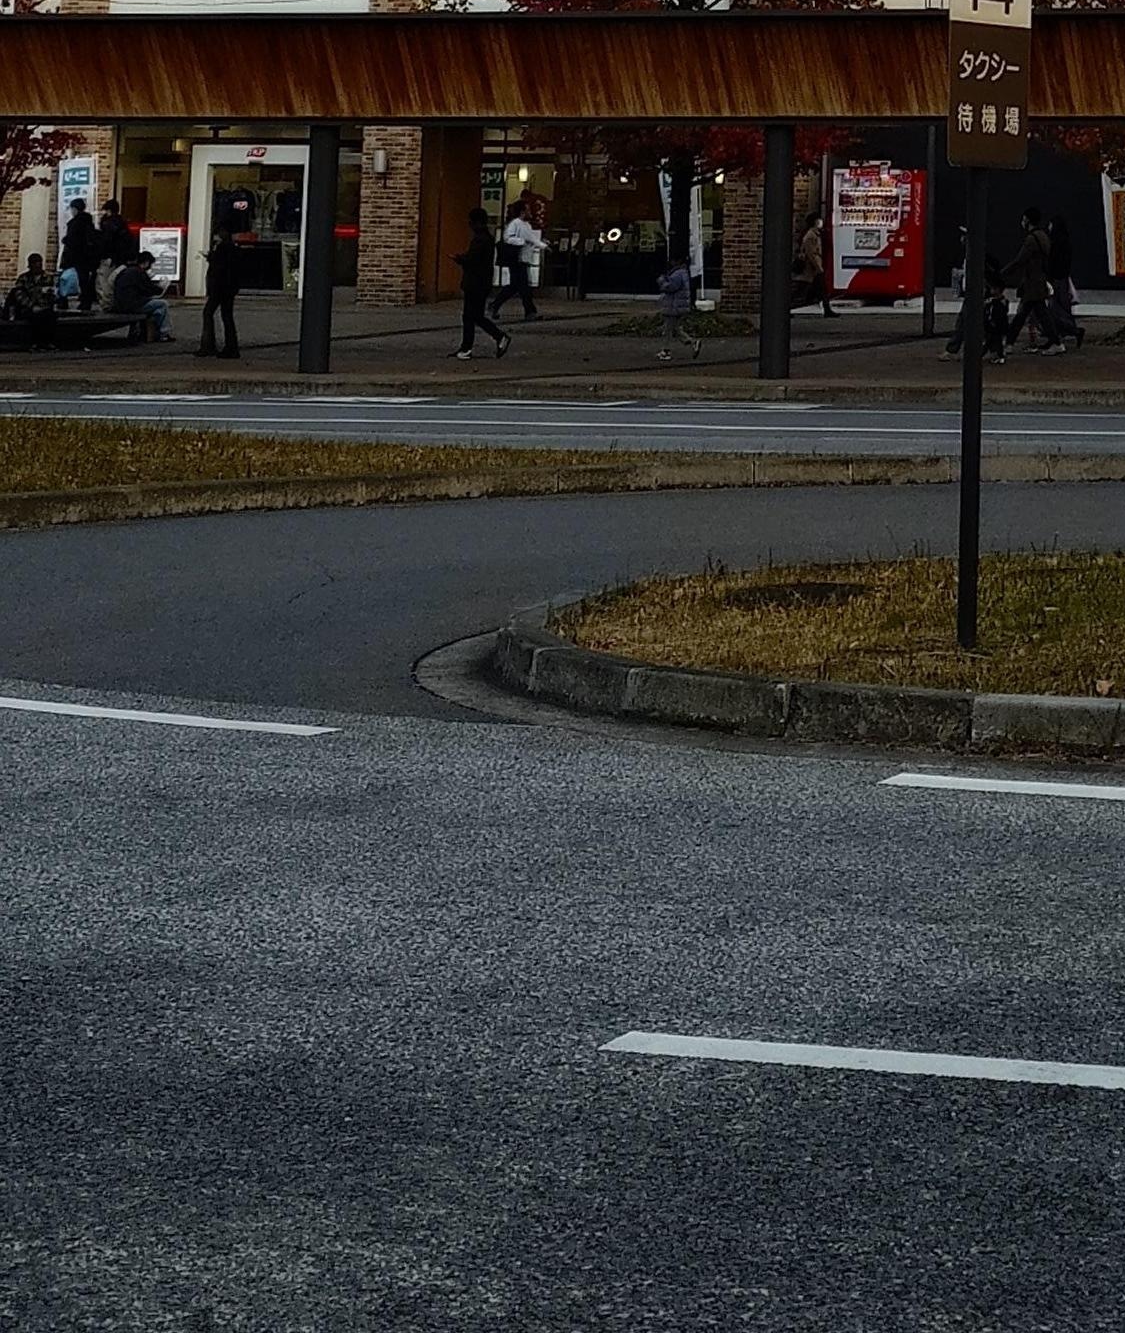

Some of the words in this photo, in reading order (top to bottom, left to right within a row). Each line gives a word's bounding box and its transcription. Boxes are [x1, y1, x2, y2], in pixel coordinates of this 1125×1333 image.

[959, 49, 1021, 81] タクシー
[957, 102, 1020, 136] 待機場
